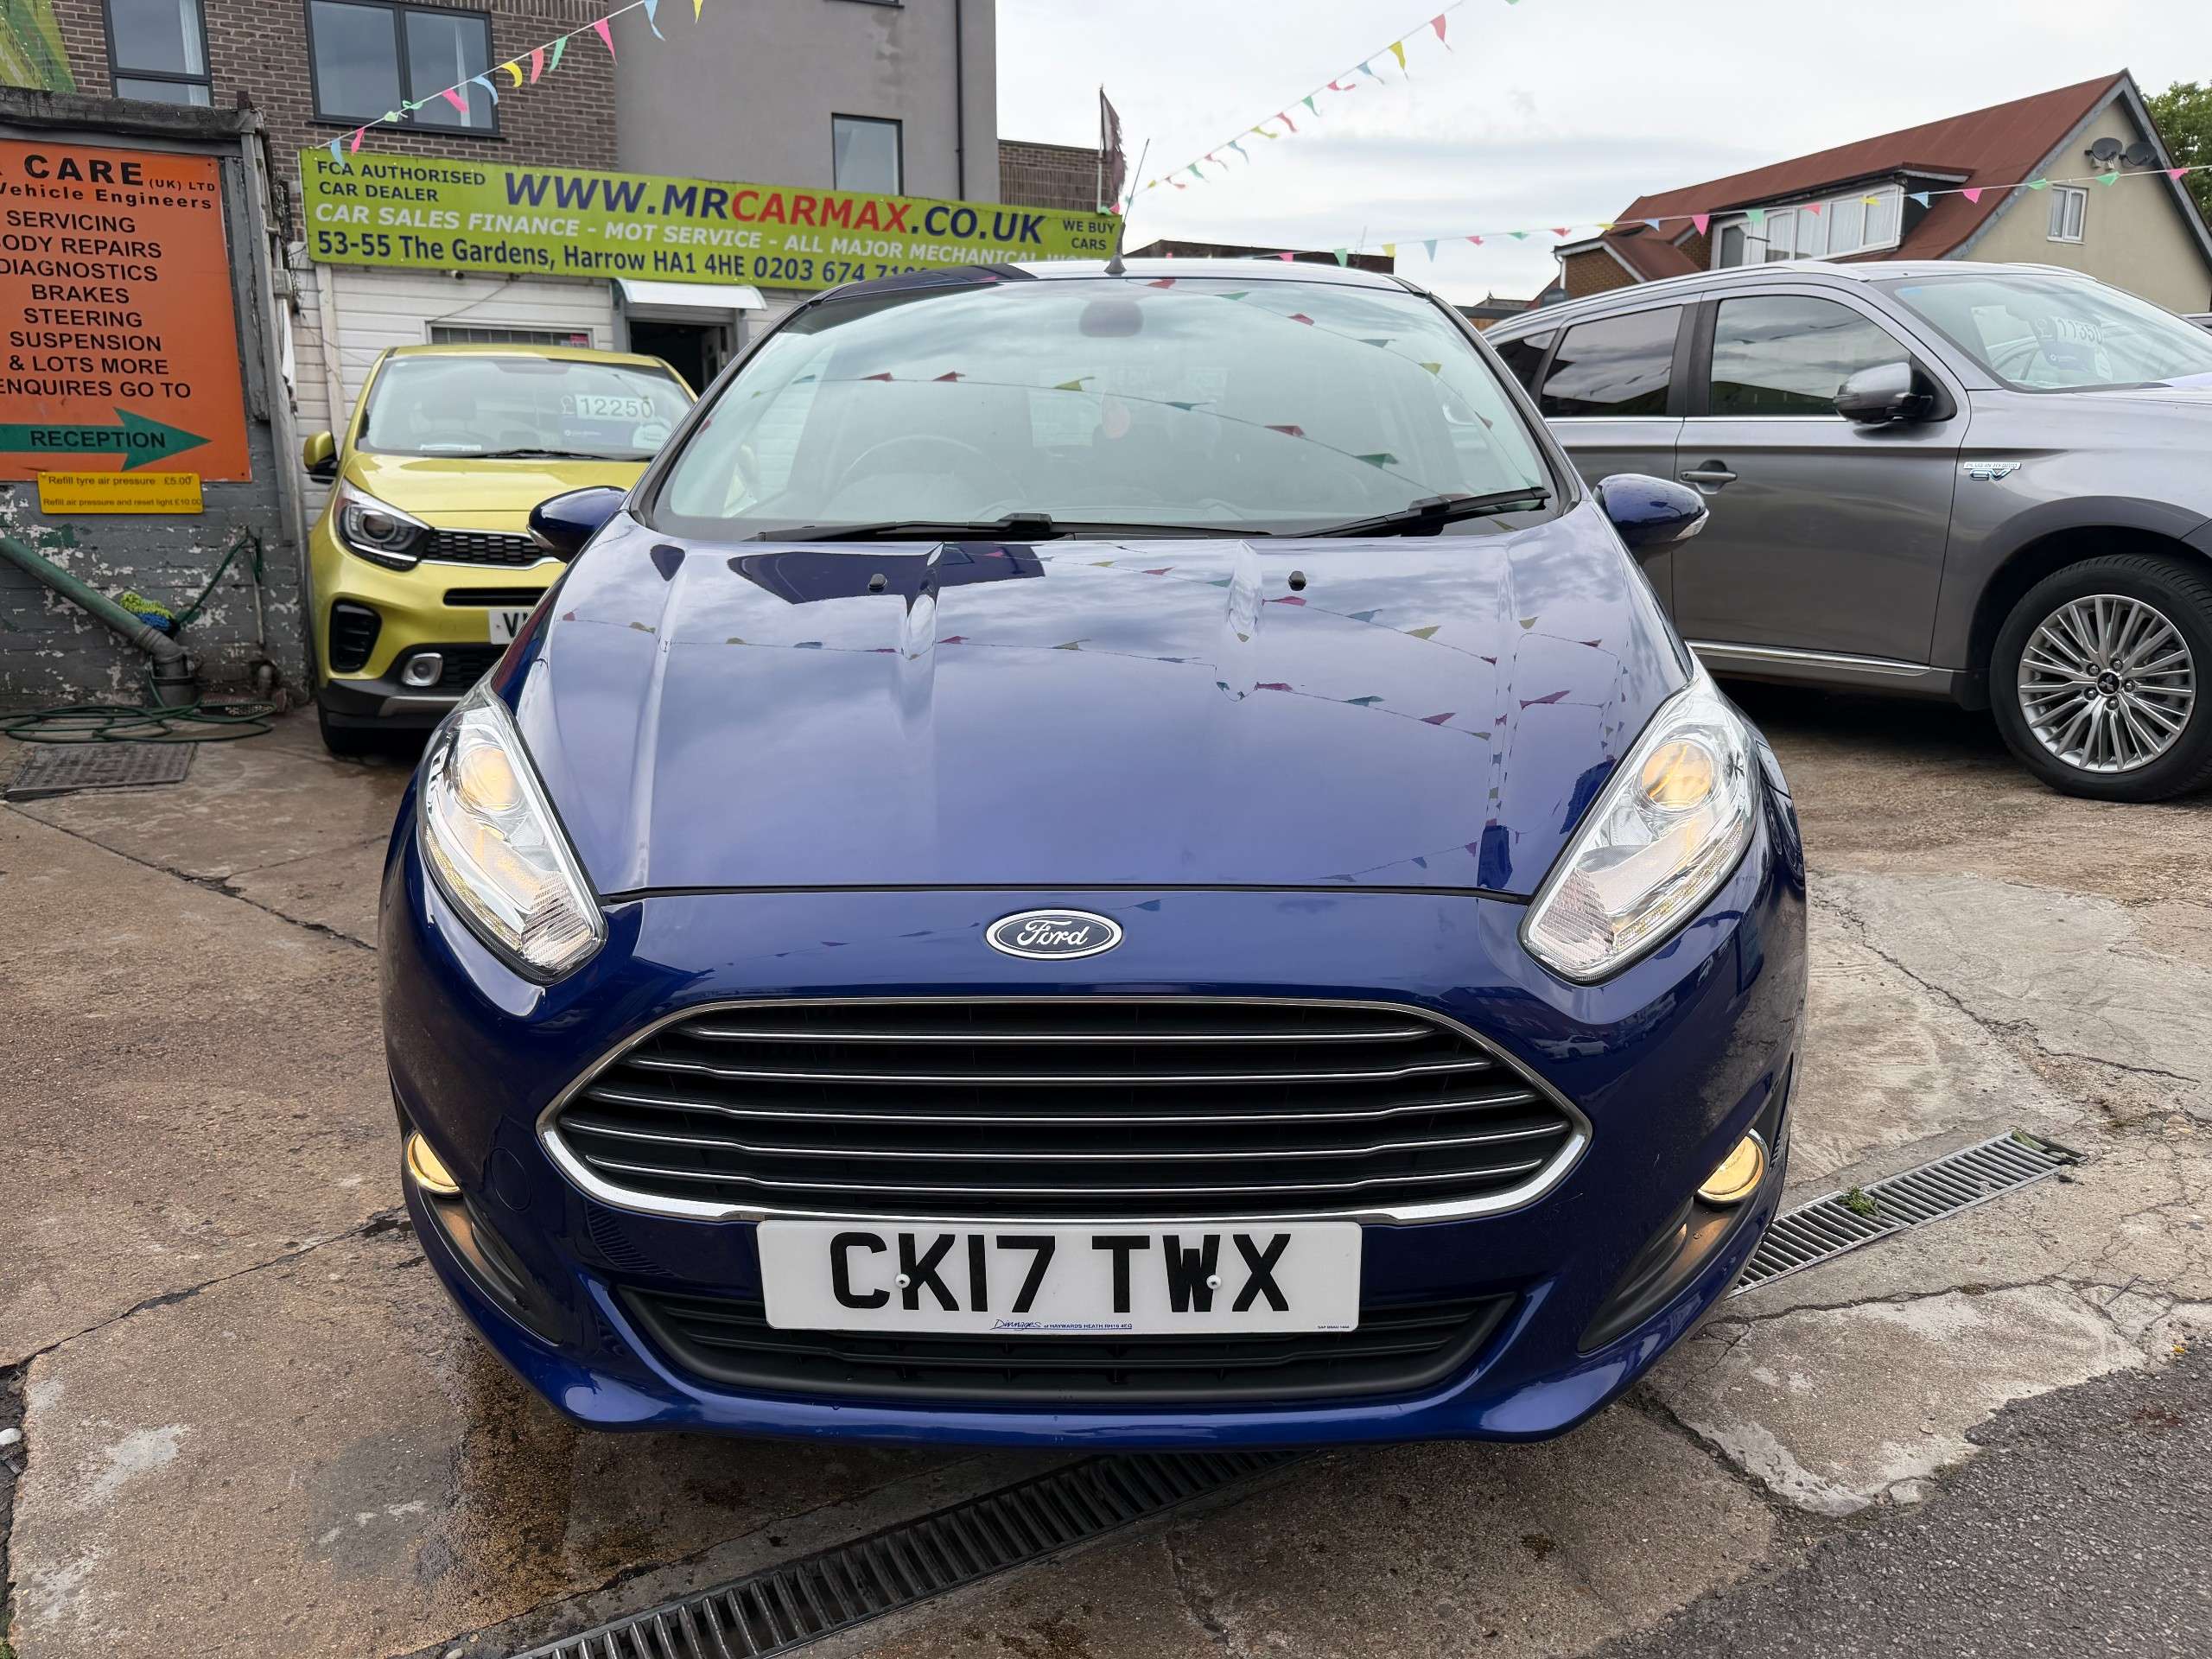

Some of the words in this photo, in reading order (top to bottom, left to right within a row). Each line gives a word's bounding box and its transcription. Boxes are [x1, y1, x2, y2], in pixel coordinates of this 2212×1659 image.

[24, 155, 143, 187] CARE
[149, 178, 181, 191] (UK)
[188, 181, 215, 192] LTD
[317, 161, 355, 176] FCA
[361, 163, 486, 186] AUTHORISED
[95, 188, 212, 209] Engineers
[320, 181, 358, 198] CAR
[366, 184, 439, 203] DEALER
[6, 210, 136, 233] SERVICING
[315, 203, 369, 225] CAR
[378, 207, 460, 231] SALES
[467, 213, 579, 238] FINANCE
[605, 222, 657, 243] MOT
[663, 225, 761, 250] SERVICE
[784, 235, 823, 255] ALL
[830, 238, 902, 259] MAJOR
[1063, 219, 1084, 232] WE
[1089, 221, 1116, 234] BUY
[0, 234, 53, 252] ODY
[61, 238, 162, 258] REPAIRS
[1071, 238, 1107, 250] CARS
[318, 230, 391, 258] 53-55
[399, 235, 444, 259] The
[452, 238, 556, 272] Gardens,
[564, 245, 645, 272] Harrow
[653, 251, 696, 275] HA1
[703, 253, 744, 277] 4HE
[753, 256, 813, 282] 0203
[822, 258, 865, 283] 674
[0, 258, 158, 282] DIAGNOSTICS
[31, 283, 130, 304] BRAKES
[23, 308, 143, 327] STEERING
[10, 331, 162, 352] SUSPENSION
[9, 355, 25, 371] &
[32, 356, 94, 373] LOTS
[101, 358, 168, 375] MORE
[120, 381, 154, 397] GO
[161, 383, 191, 398] TO
[30, 430, 166, 448] RECEPTION
[48, 476, 73, 485] Refill
[76, 478, 94, 486] tyre
[113, 478, 156, 486] pressure
[43, 498, 65, 506] Refill
[156, 499, 173, 507] light
[1017, 919, 1090, 945] Ford
[830, 1231, 1056, 1313] CK17
[1090, 1234, 1292, 1313] TWX
